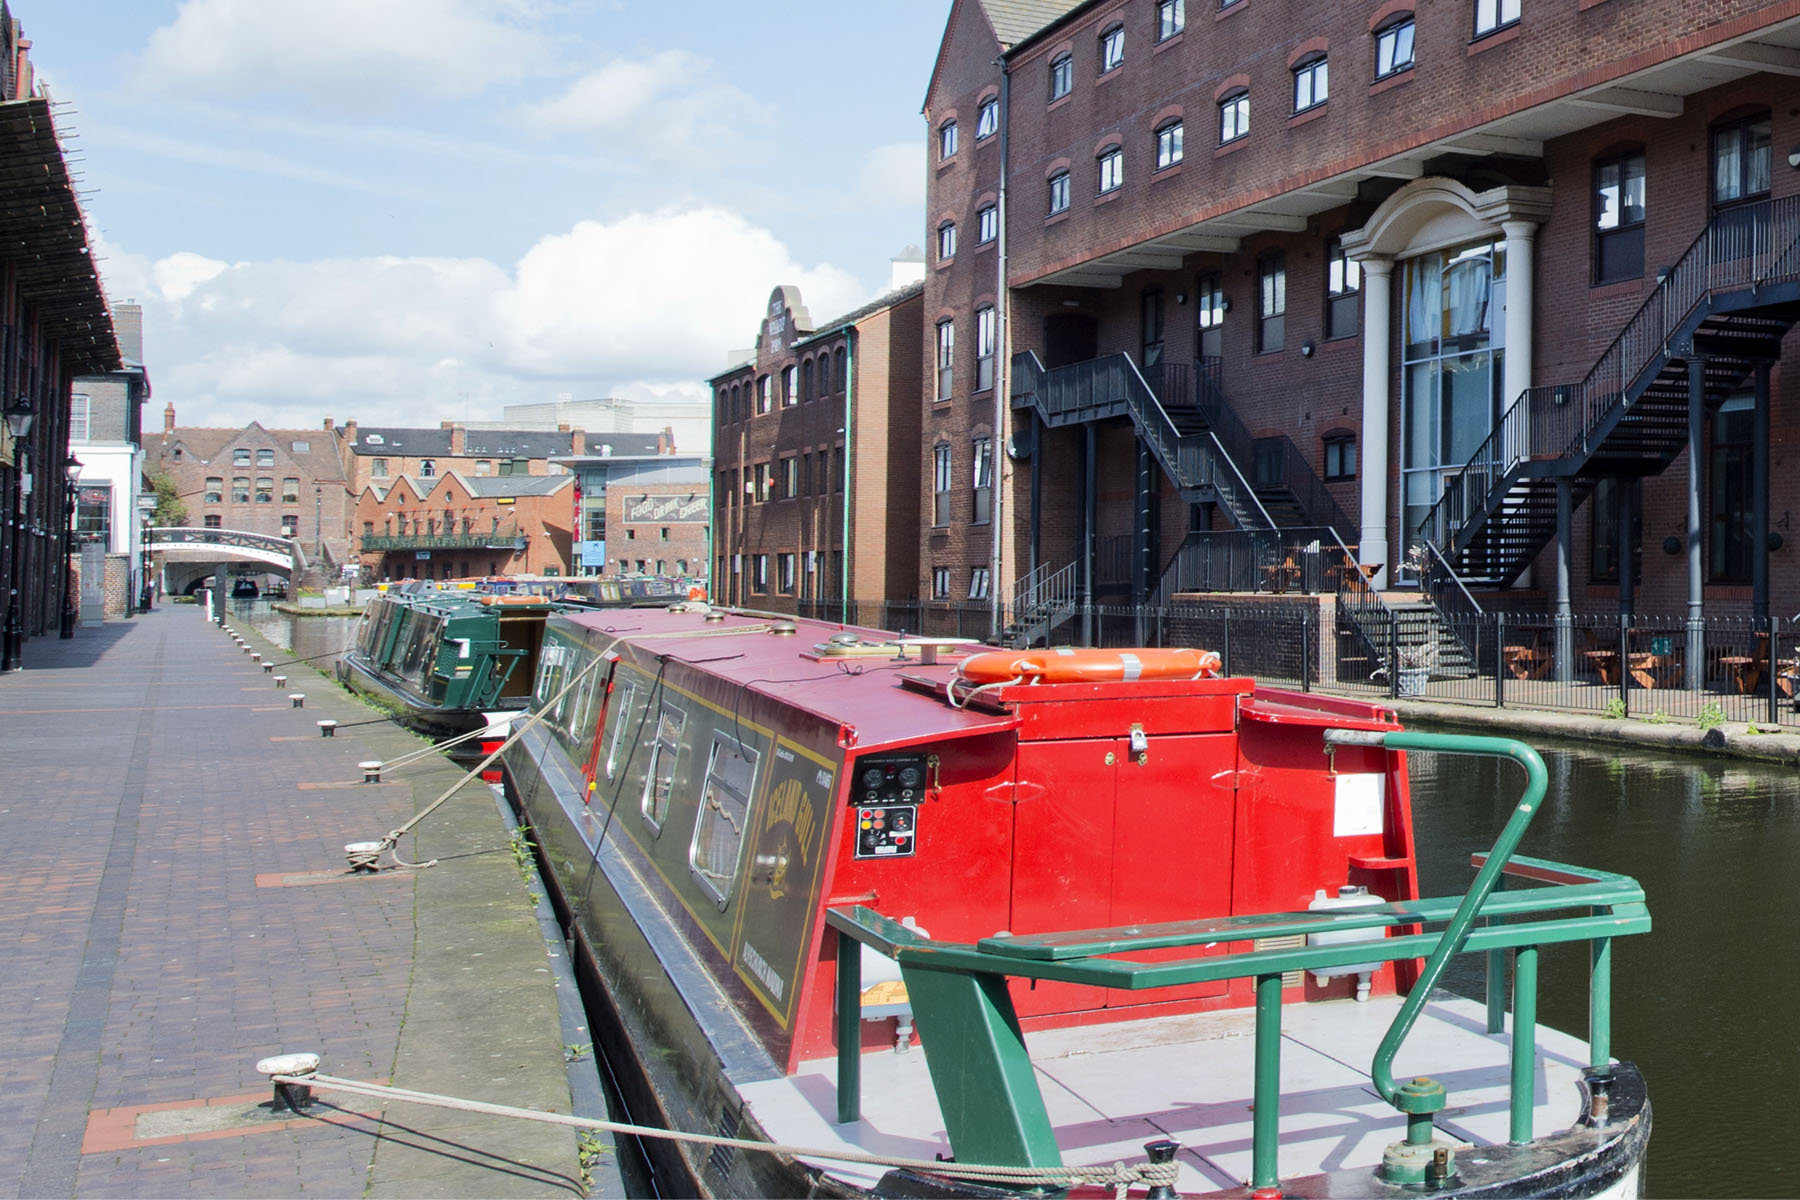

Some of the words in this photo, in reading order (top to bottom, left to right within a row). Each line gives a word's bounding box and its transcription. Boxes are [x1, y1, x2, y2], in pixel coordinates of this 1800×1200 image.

[631, 498, 654, 520] FOOD
[653, 497, 680, 520] DRINK
[679, 498, 709, 519] CHEER
[795, 791, 816, 867] GULL
